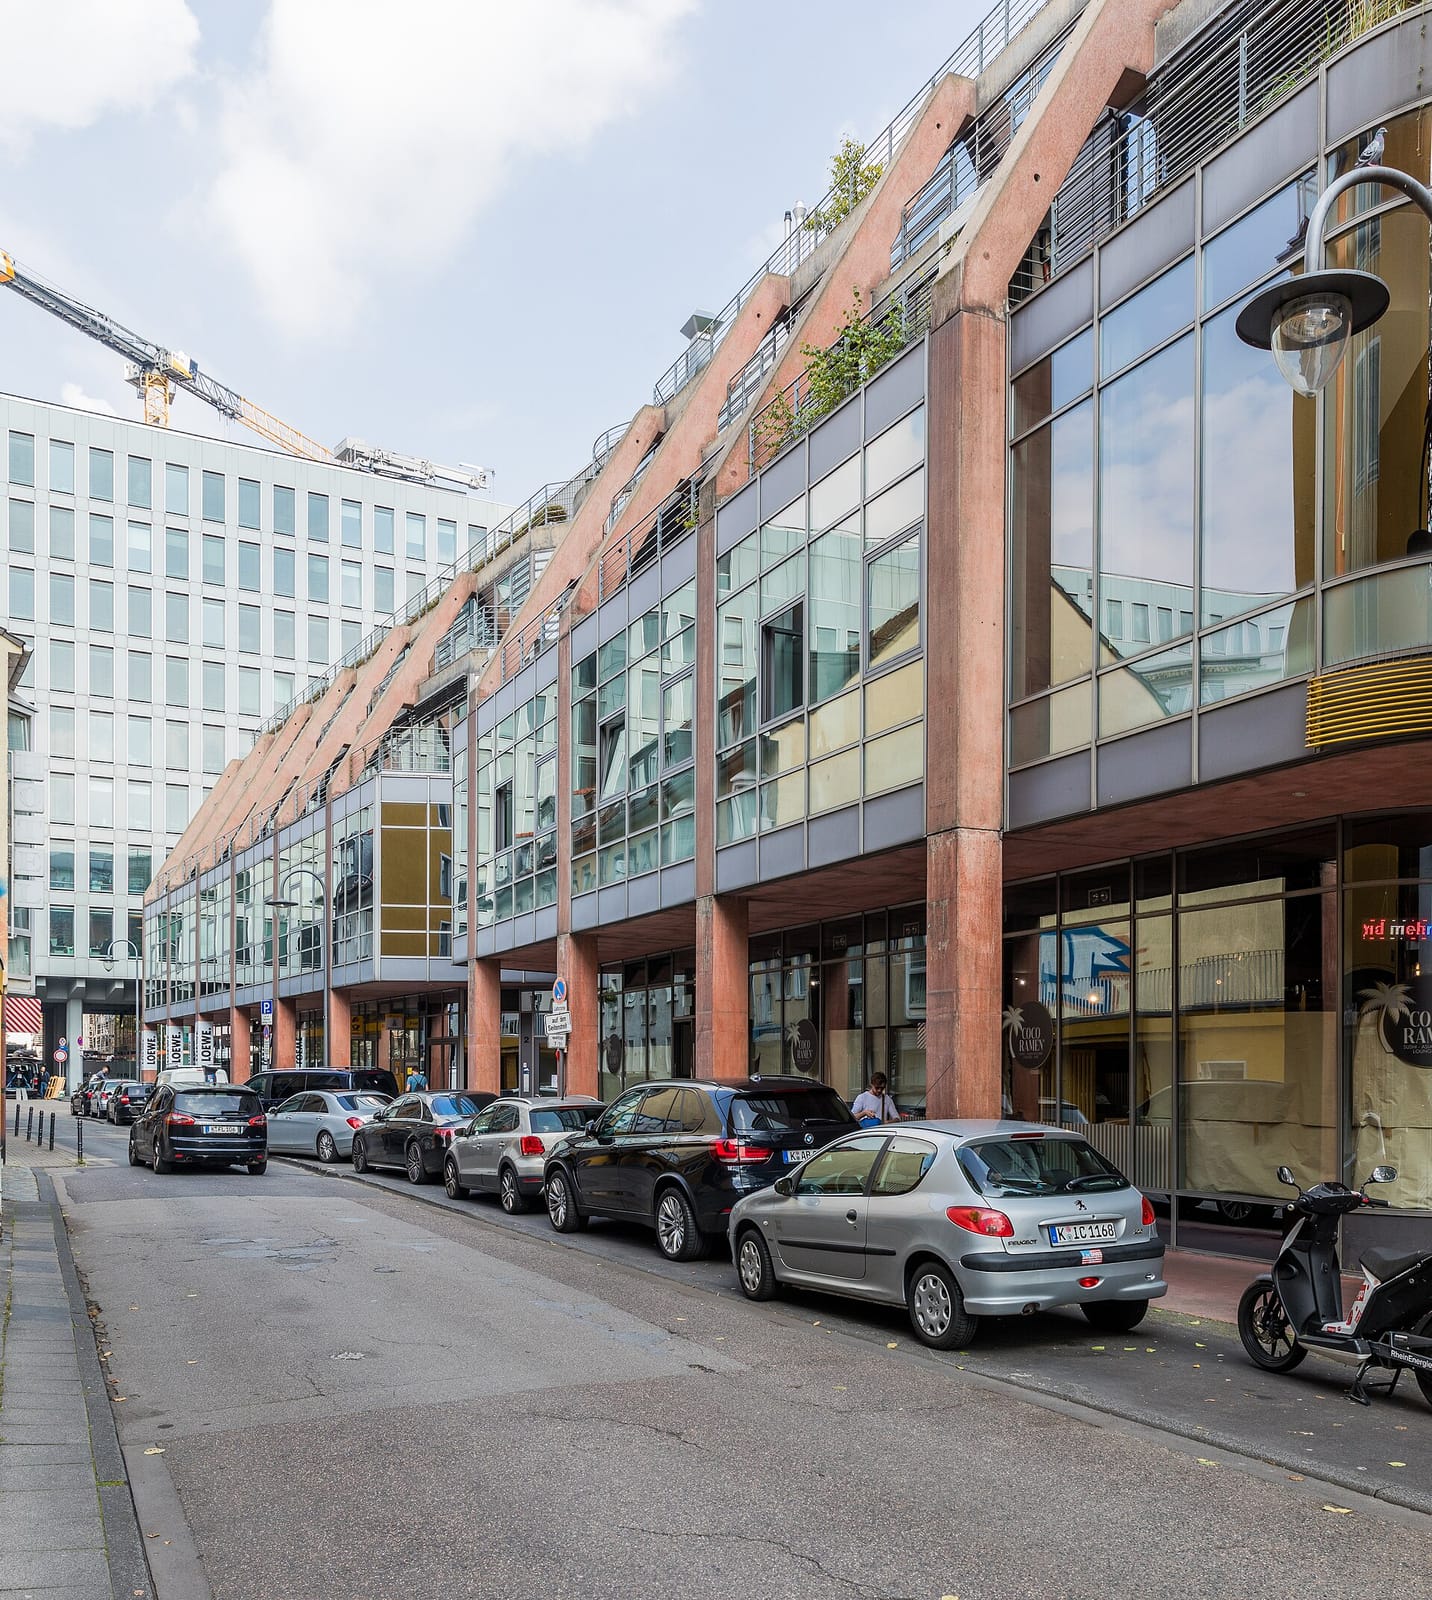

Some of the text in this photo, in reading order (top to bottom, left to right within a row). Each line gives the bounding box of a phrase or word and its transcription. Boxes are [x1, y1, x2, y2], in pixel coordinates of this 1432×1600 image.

[1022, 1027, 1040, 1040] COCO
[1020, 1040, 1044, 1051] RAMEN
[1057, 1228, 1066, 1240] K
[1088, 1224, 1114, 1238] 1168
